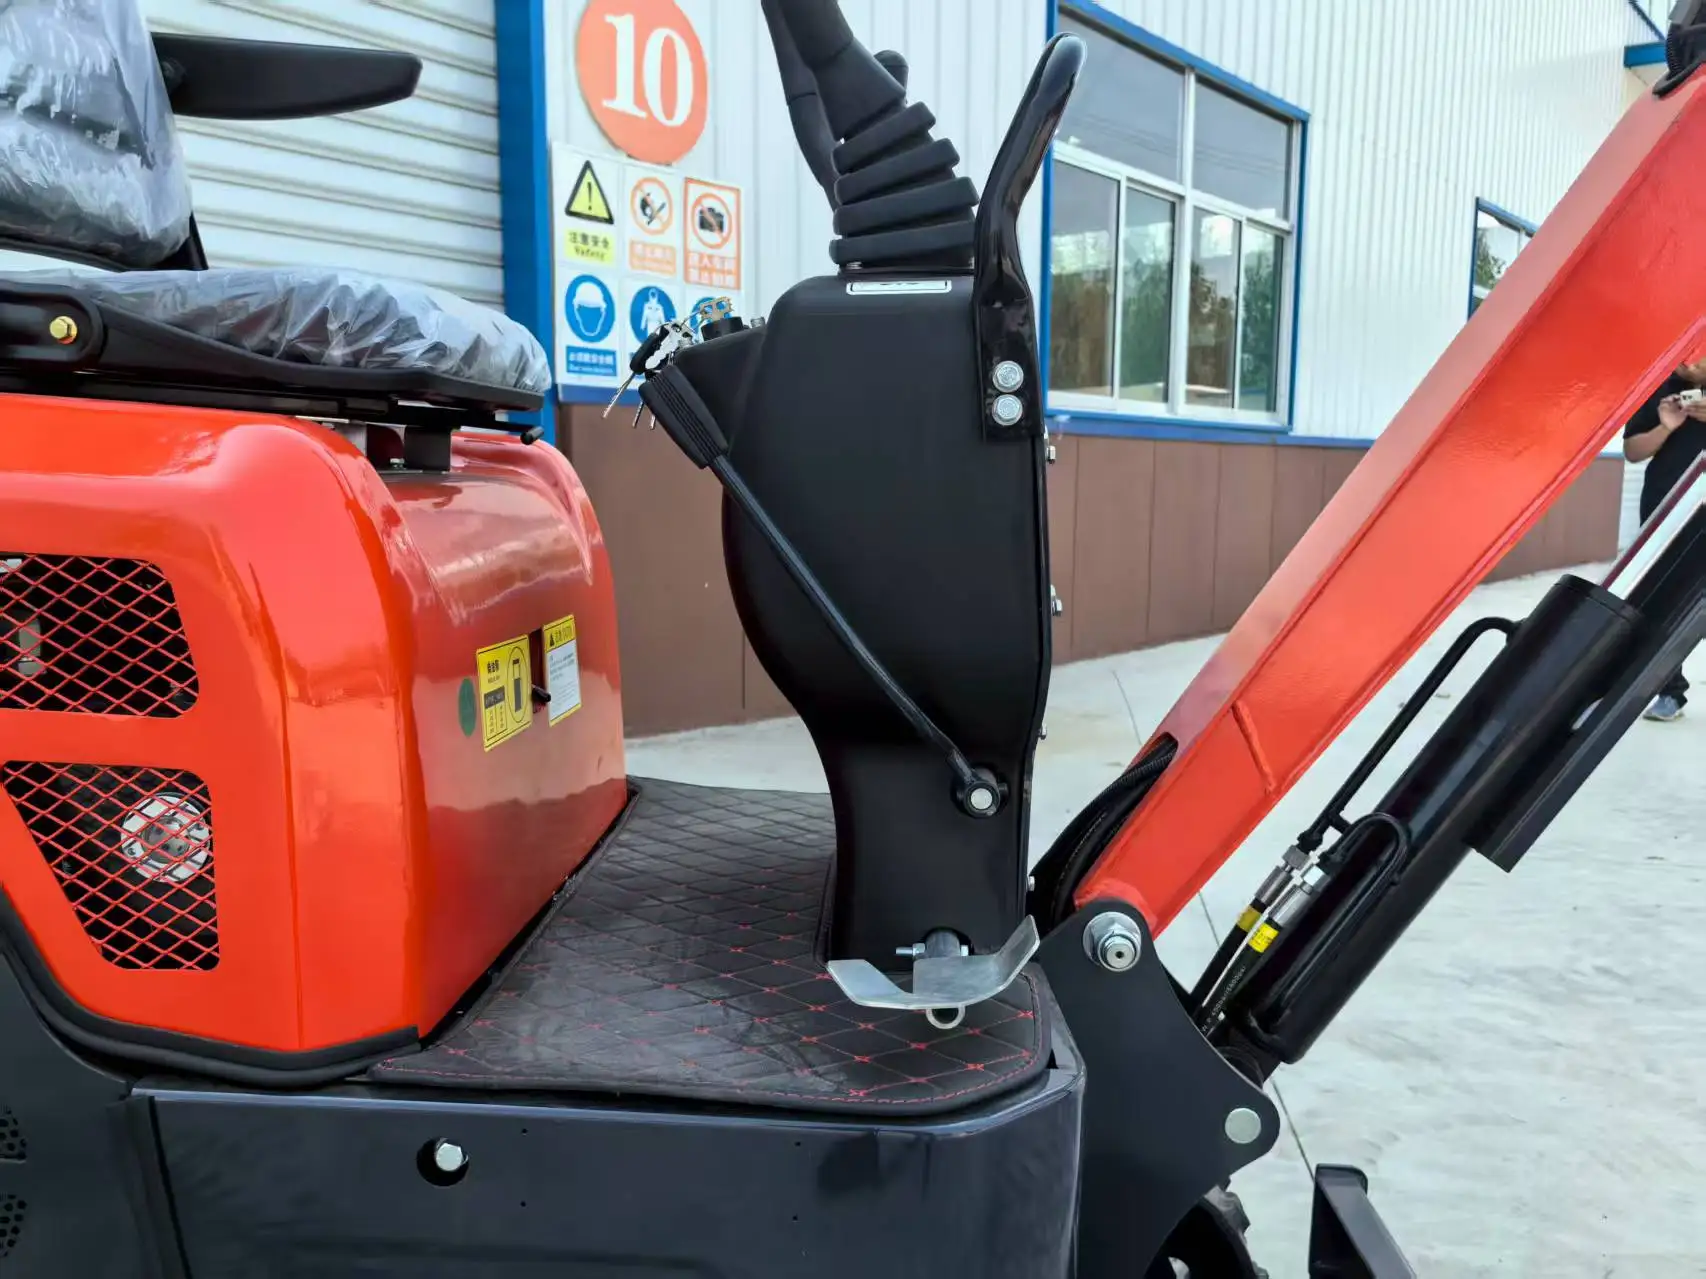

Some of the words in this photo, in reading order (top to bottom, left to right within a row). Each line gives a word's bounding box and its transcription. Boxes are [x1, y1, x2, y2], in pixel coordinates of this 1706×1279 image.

[602, 13, 693, 127] 10
[569, 231, 609, 249] 注意安全
